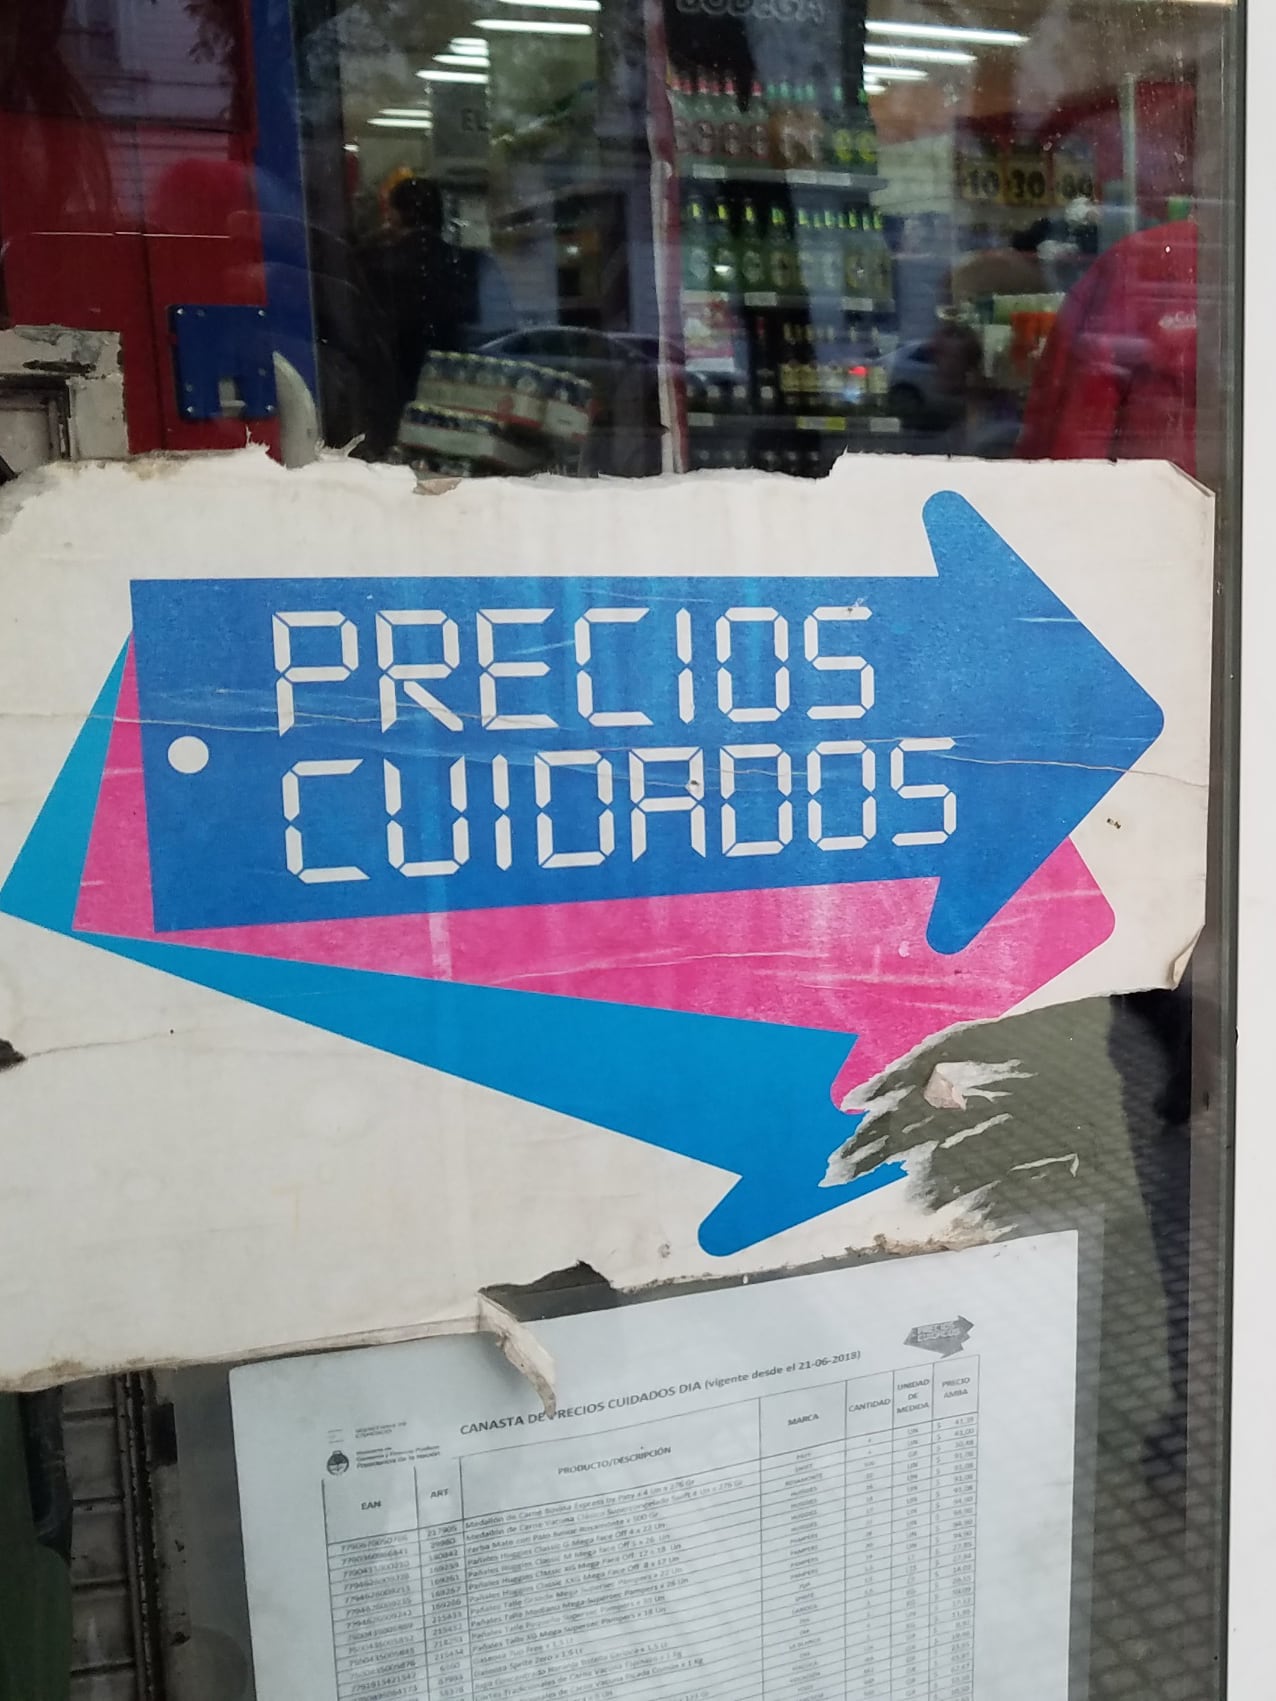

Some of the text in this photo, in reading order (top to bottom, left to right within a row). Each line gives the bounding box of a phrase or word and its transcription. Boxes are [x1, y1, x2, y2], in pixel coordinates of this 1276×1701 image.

[272, 607, 876, 736] PRECIOS
[282, 737, 957, 884] CUIDADOS
[897, 1378, 930, 1391] UNIDAD
[460, 1415, 525, 1436] CANASTA
[528, 1412, 546, 1424] DE
[608, 1386, 677, 1412] CUIDADOS
[679, 1381, 703, 1397] DIA
[704, 1370, 750, 1393] (vigente
[752, 1364, 784, 1381] desde
[786, 1361, 797, 1374] el
[798, 1349, 862, 1372] 21-06-2018)
[908, 1392, 919, 1401] DE
[849, 1398, 891, 1413] CANTIDAD
[787, 1412, 820, 1427] MARCA
[558, 1446, 672, 1476] PRODUCTO/DESCRIPCIÓN
[361, 1499, 383, 1511] EAN
